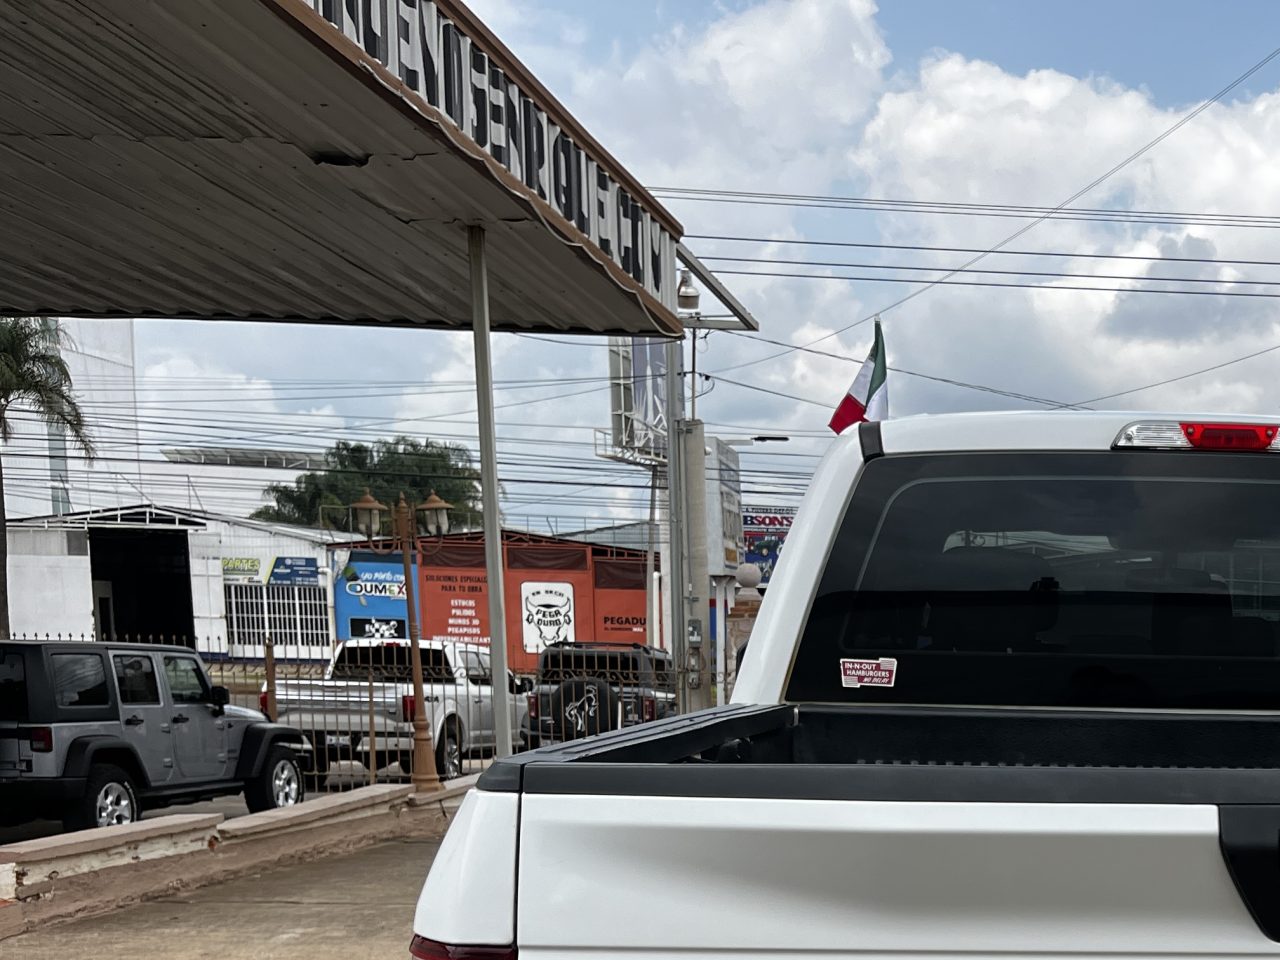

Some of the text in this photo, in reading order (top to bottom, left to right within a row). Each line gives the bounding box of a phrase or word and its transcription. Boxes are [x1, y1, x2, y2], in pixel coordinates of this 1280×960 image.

[222, 557, 260, 570] PARTES
[536, 609, 562, 618] PEGA
[846, 669, 890, 677] HAMBURGERS
